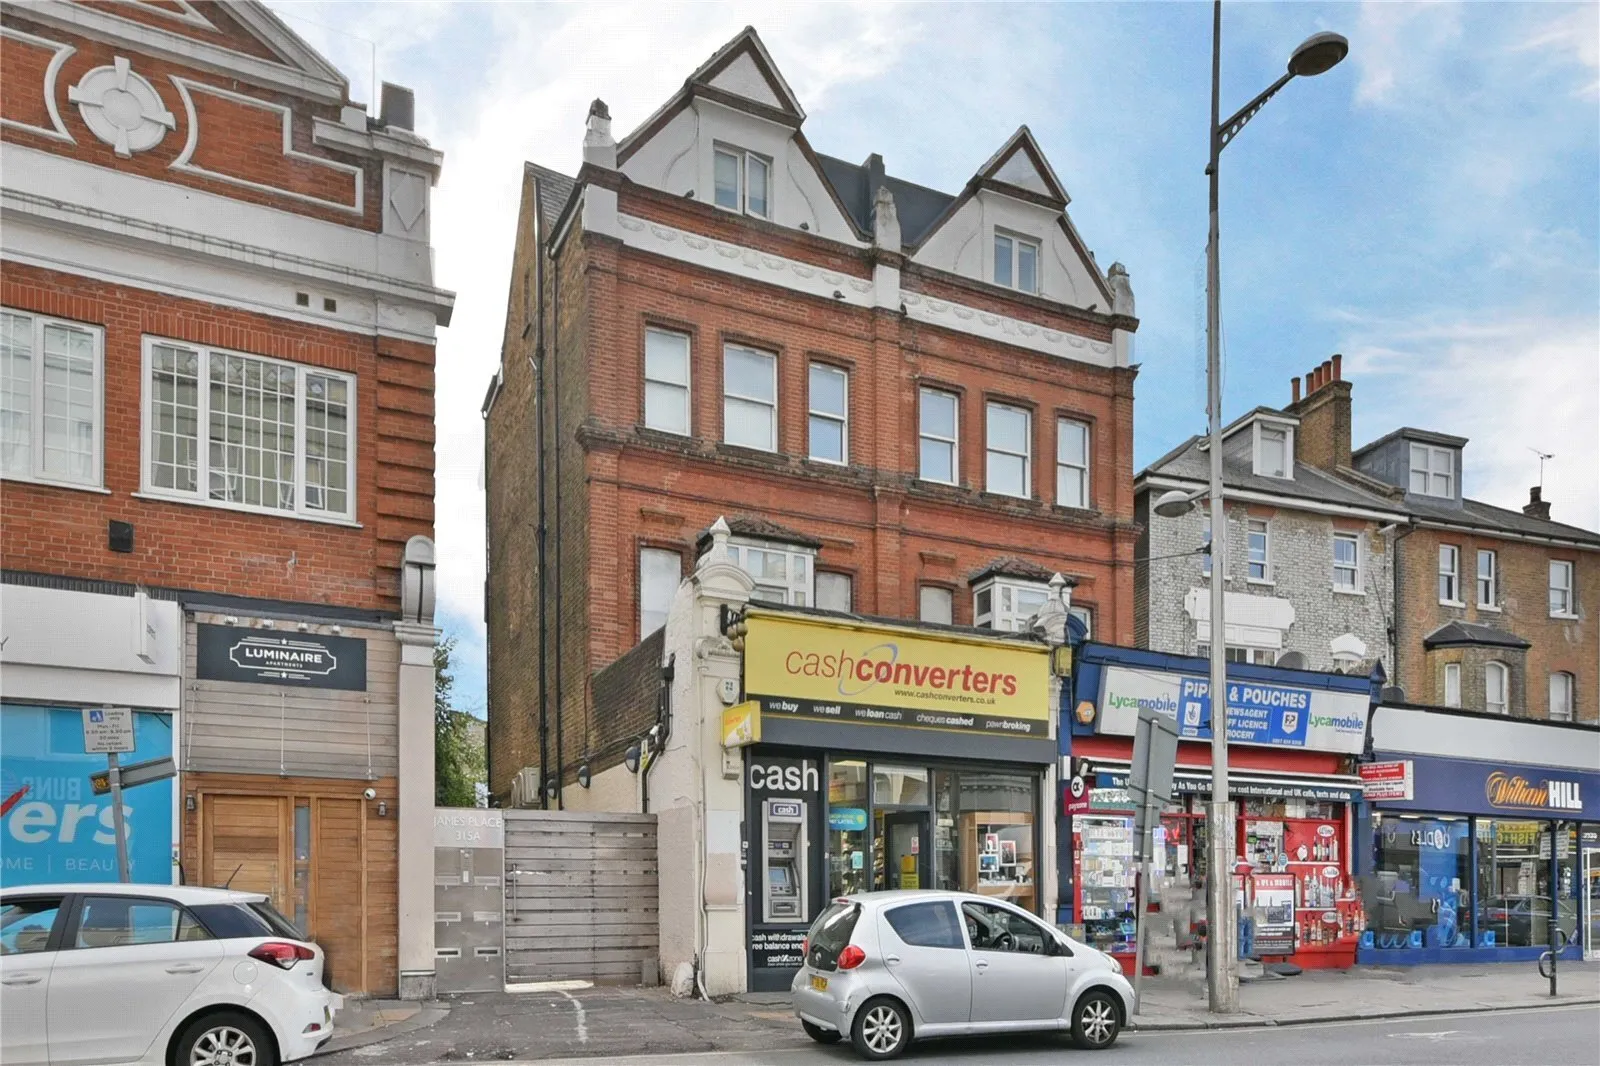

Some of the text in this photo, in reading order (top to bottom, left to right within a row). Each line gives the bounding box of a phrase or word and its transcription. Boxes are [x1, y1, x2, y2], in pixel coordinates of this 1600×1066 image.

[245, 647, 323, 664] LUMINAIRE
[265, 660, 303, 669] APARTMENTS
[894, 689, 996, 705] www.cashconverters.co.uk
[1108, 692, 1177, 712] Lycamobile
[1184, 681, 1307, 709] PIP & POUCHES
[769, 700, 799, 713] we buy
[813, 705, 841, 715] we sell
[855, 708, 903, 720] we loan cash
[916, 713, 974, 727] cheques cashed
[1309, 712, 1364, 730] Lycamobile
[985, 720, 1031, 733] pawnbroking
[1227, 718, 1268, 730] FF LICENCE
[1226, 729, 1255, 739] ROCERY
[750, 759, 819, 791] cash
[1112, 777, 1124, 786] The
[1238, 786, 1249, 794] cost
[1250, 786, 1283, 796] International
[1284, 787, 1293, 796] and
[1294, 788, 1302, 797] UK
[1316, 790, 1328, 799] texts
[1330, 791, 1339, 799] and
[1486, 771, 1583, 809] William HILL
[0, 786, 133, 845] ers
[777, 806, 795, 815] cash
[468, 816, 502, 828] PLACE
[65, 857, 136, 872] BEAUY
[764, 942, 790, 950] balance
